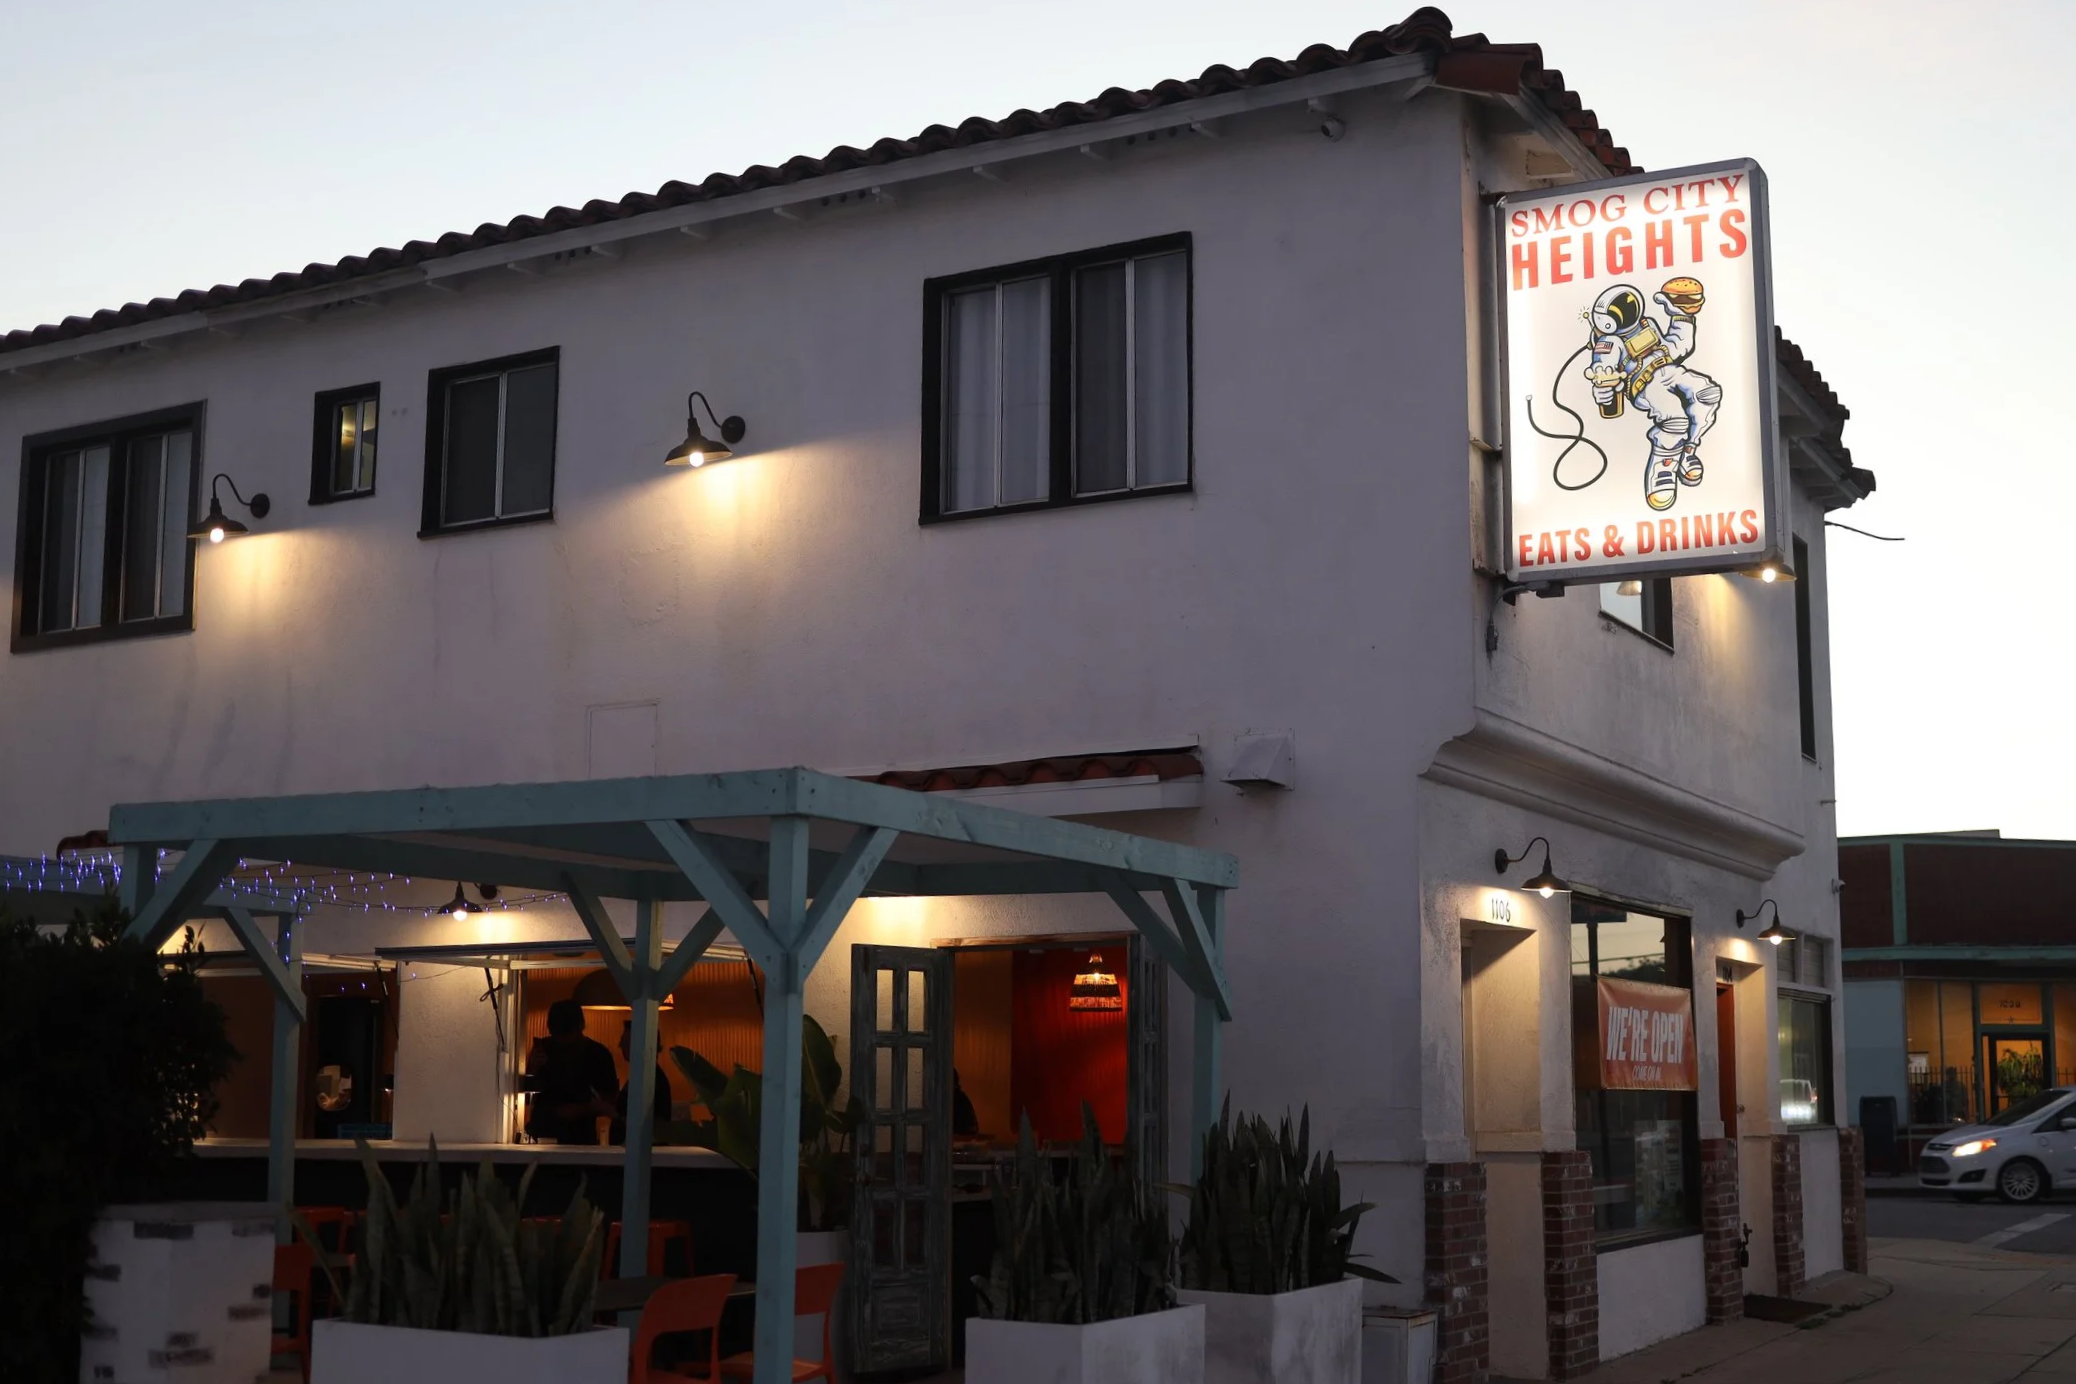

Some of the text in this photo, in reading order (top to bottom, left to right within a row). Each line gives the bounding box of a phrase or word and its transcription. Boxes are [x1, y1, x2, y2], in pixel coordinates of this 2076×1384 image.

[1511, 174, 1744, 238] SMOG CITY
[1512, 208, 1747, 291] HEIGHTS
[1519, 509, 1758, 567] EATS & DRINKS
[1491, 898, 1511, 922] 1106
[1607, 1007, 1683, 1063] WE'RE OPEN
